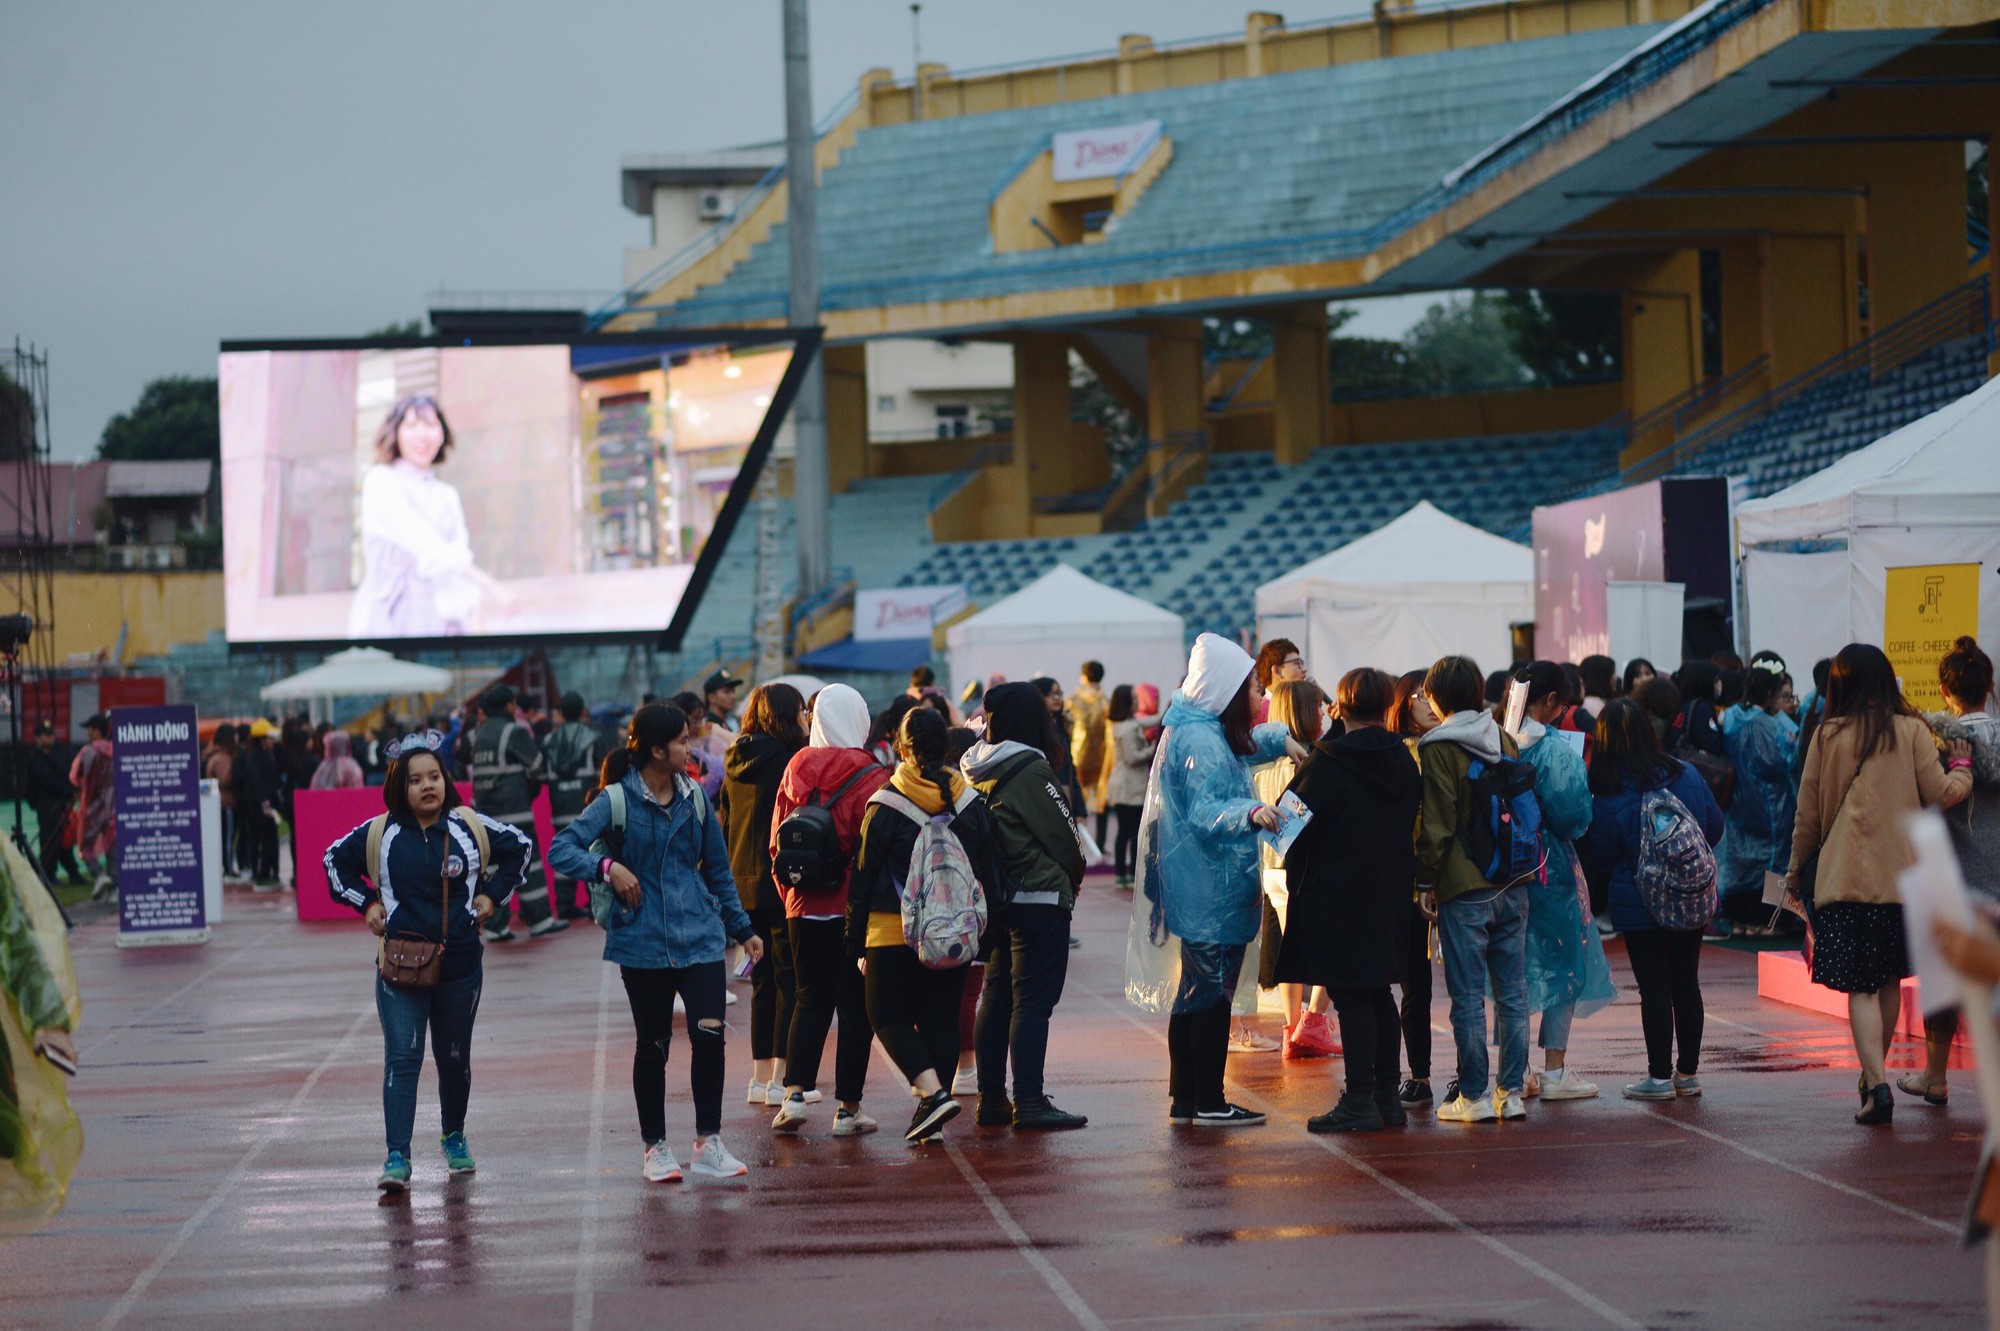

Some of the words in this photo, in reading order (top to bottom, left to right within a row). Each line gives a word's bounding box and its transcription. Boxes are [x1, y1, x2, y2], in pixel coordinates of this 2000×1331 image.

[1888, 641, 1916, 653] COFFEE
[1923, 639, 1952, 652] CHEESE
[118, 721, 153, 744] HÀNH
[155, 720, 189, 745] ĐỘNG
[1044, 782, 1061, 800] TRY
[1056, 800, 1070, 818] AND
